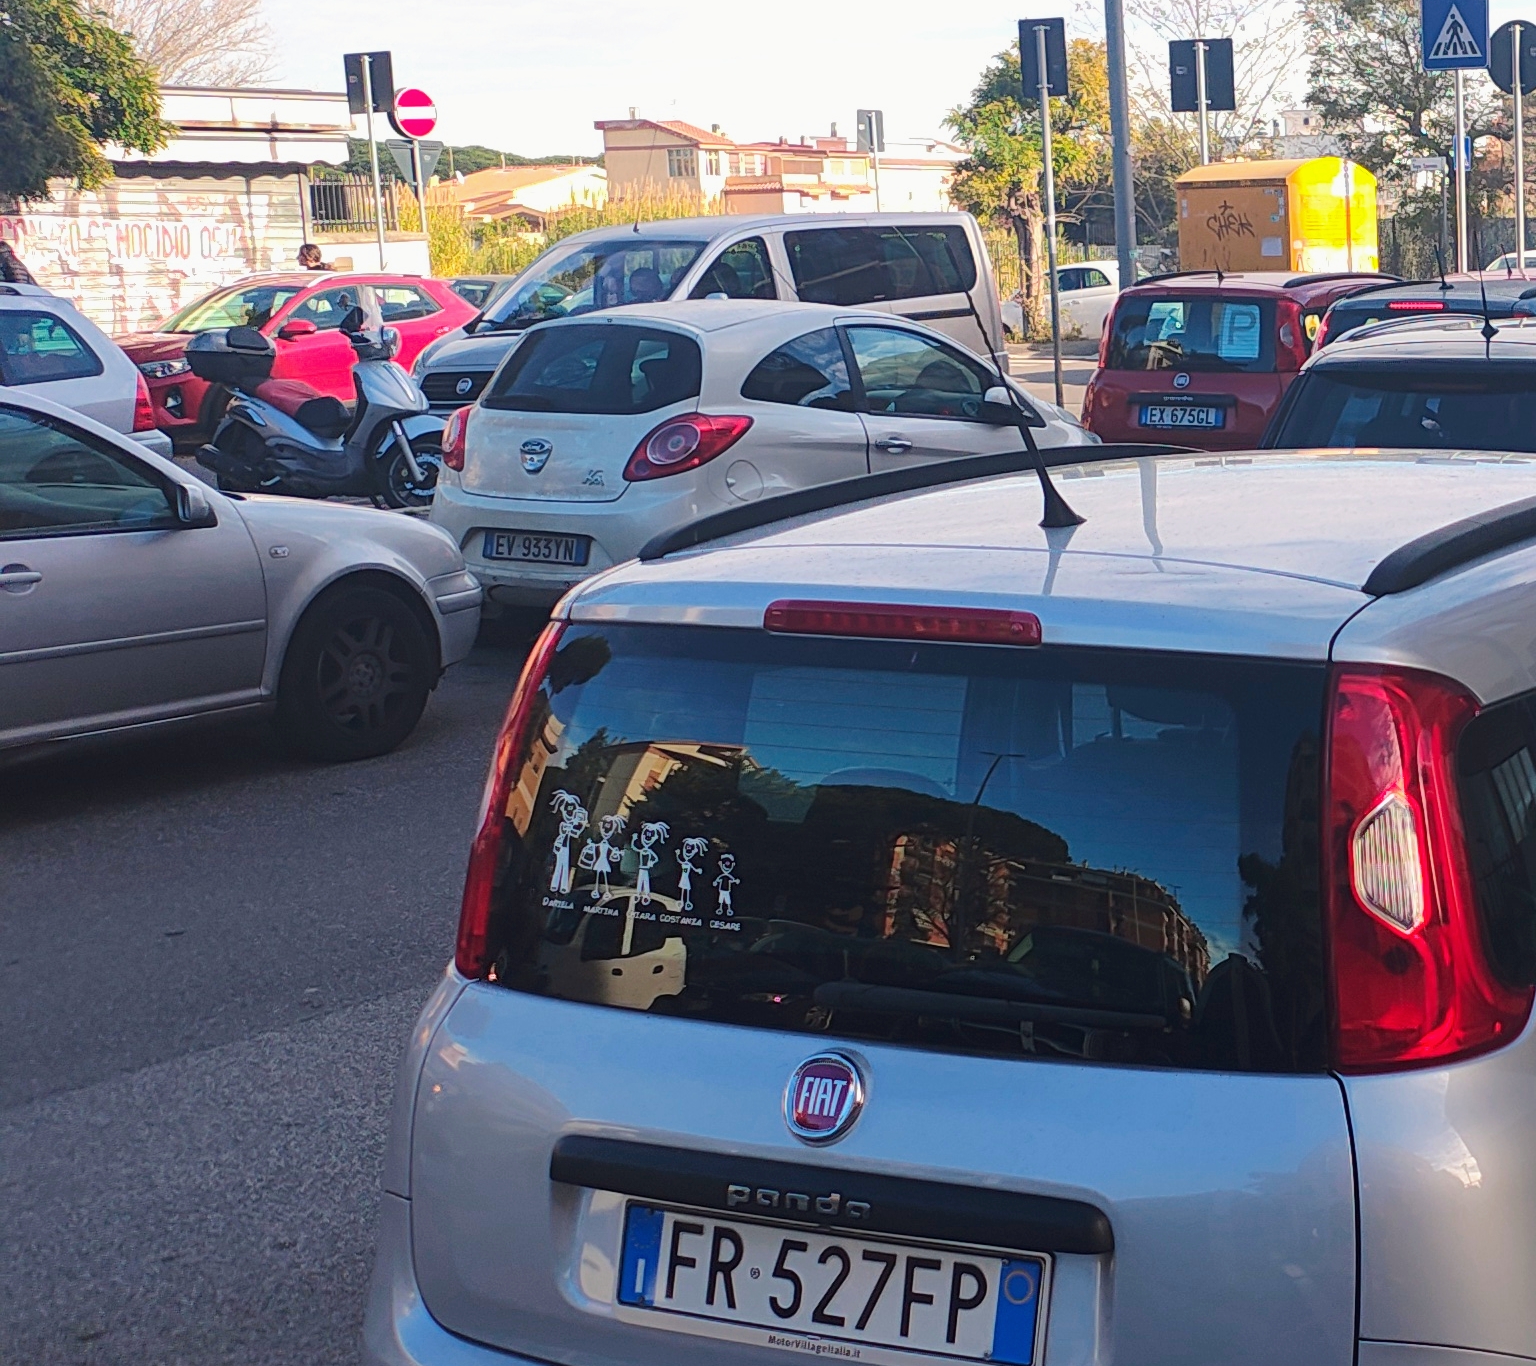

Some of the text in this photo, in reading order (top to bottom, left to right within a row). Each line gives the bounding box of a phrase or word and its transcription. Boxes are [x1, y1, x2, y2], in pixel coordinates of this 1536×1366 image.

[1149, 407, 1214, 425] EX 675GL
[495, 535, 575, 561] EV 933YN
[582, 904, 620, 917] MARTINA
[659, 913, 703, 927] COSTANZA
[709, 919, 741, 932] CESARE
[801, 1076, 848, 1118] FIAT
[726, 1184, 872, 1220] panda
[664, 1218, 745, 1310] FR
[768, 1237, 989, 1344] 527FP
[768, 1335, 861, 1359] MotorVillageItalia.it
